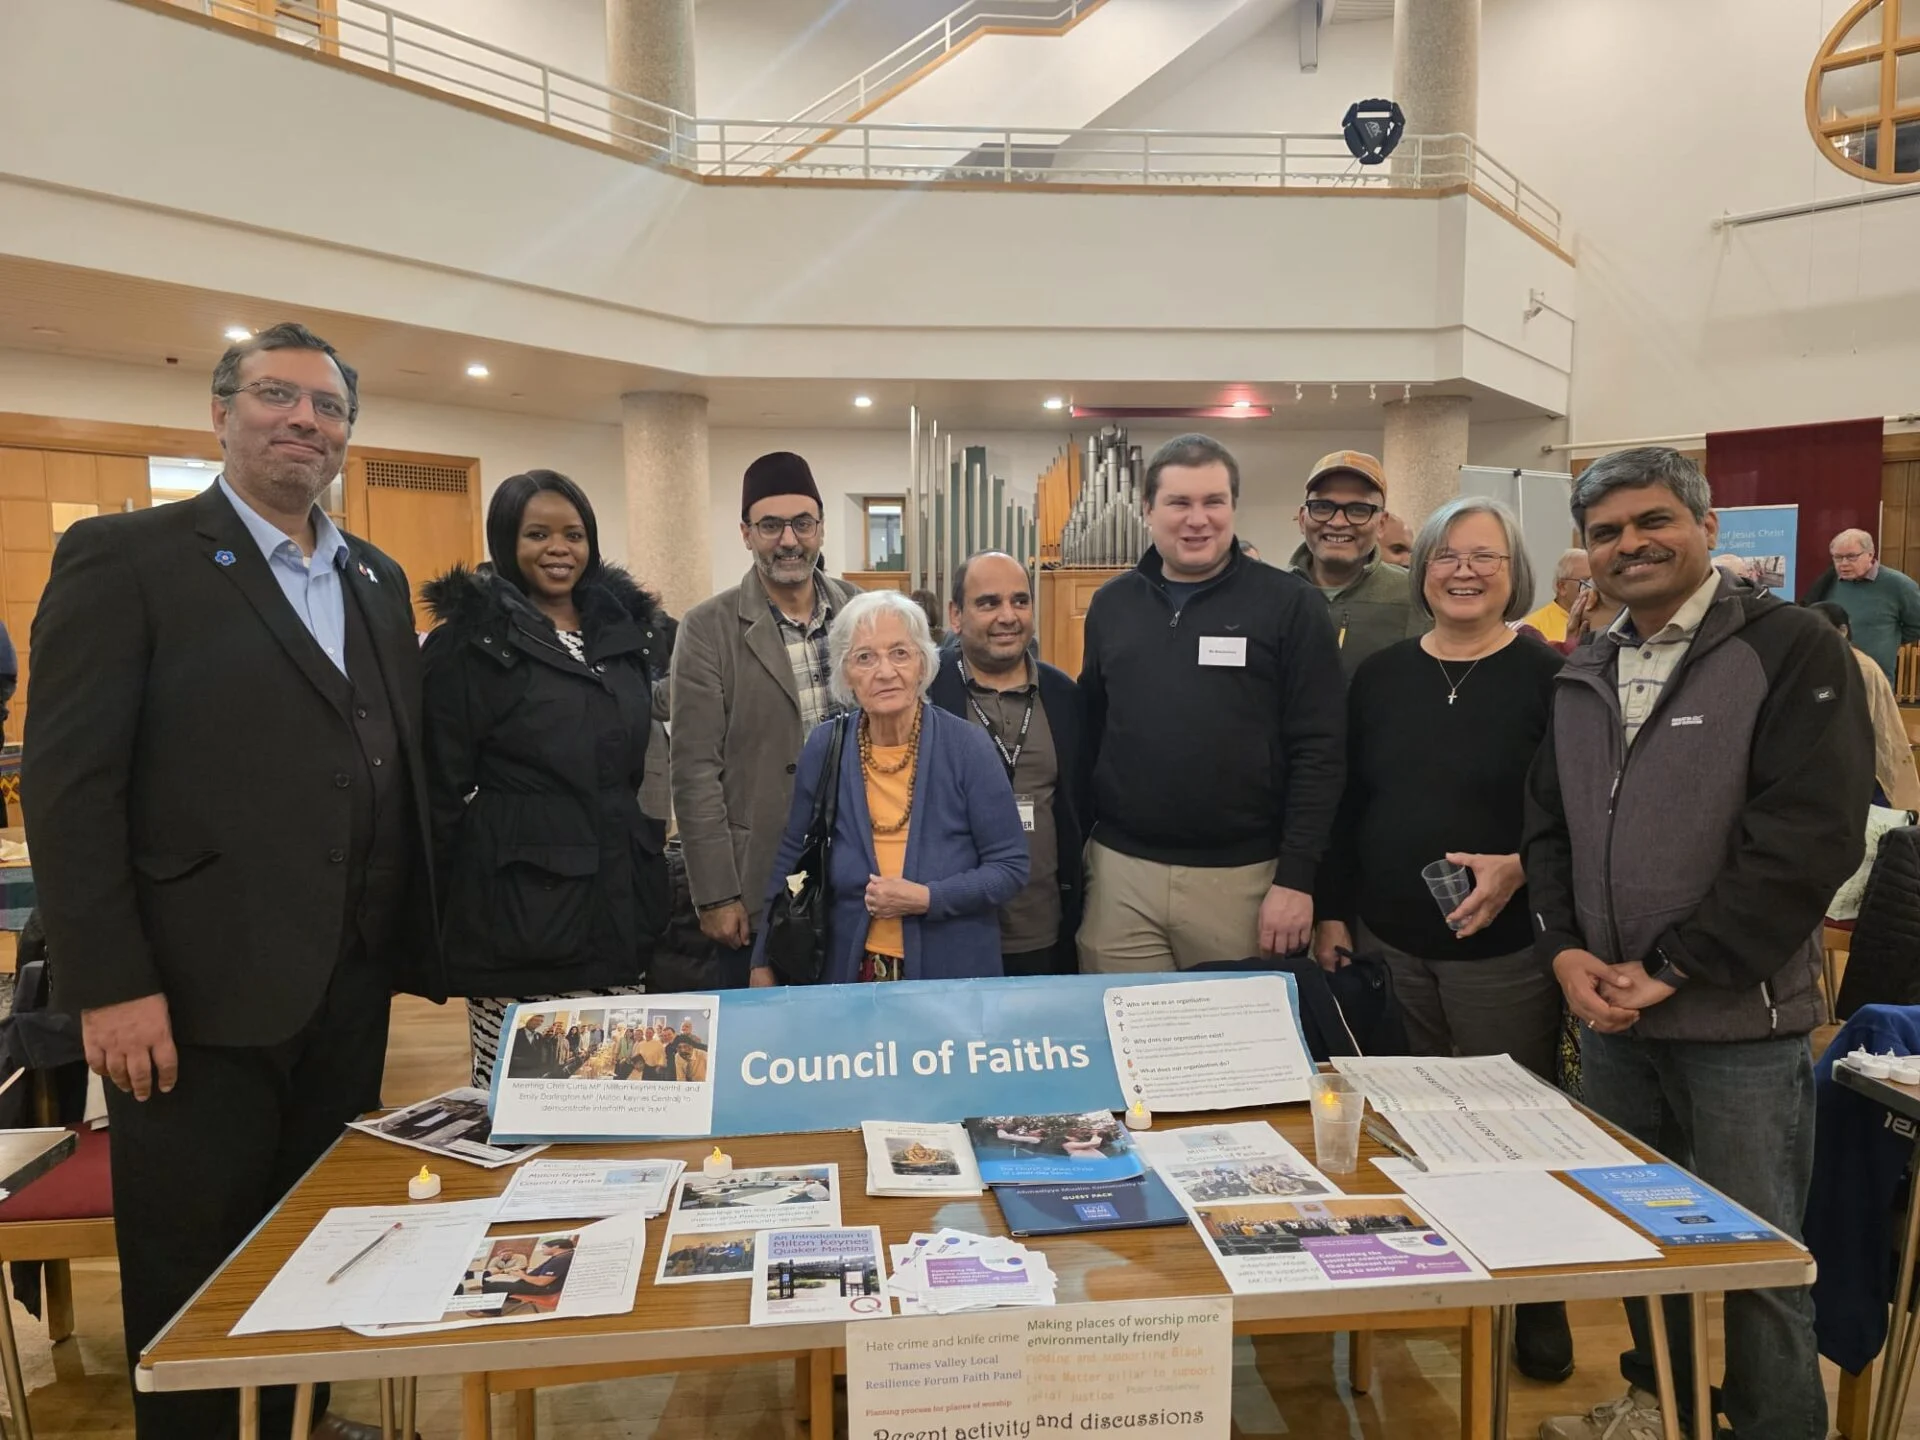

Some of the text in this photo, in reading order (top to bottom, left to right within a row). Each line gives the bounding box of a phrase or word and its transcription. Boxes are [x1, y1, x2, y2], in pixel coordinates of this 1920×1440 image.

[1732, 530, 1756, 540] Jesus
[1758, 528, 1785, 537] Christ
[741, 1037, 1090, 1085] Council of Faiths
[512, 1082, 545, 1090] Meeting
[631, 1083, 656, 1092] Keynes
[1601, 1170, 1658, 1179] JESUS
[773, 1239, 869, 1248] Milton Keynes
[773, 1246, 869, 1255] Quaker Meeting
[1319, 1251, 1368, 1259] Celebrating
[1346, 1260, 1382, 1268] different
[1366, 1266, 1396, 1274] society
[1027, 1312, 1220, 1334] Making places of worship more
[866, 1332, 1020, 1352] Hate crime and knife crime
[1027, 1330, 1180, 1348] environmentally friendly
[888, 1354, 999, 1372] Thames Valley Local
[1077, 1352, 1096, 1363] and
[1102, 1350, 1167, 1364] supporting
[1172, 1346, 1204, 1358] Black
[866, 1369, 1022, 1390] Resilience Forum Faith Panel
[1063, 1370, 1101, 1383] Matter
[1108, 1369, 1145, 1384] pillar
[1153, 1367, 1167, 1378] to
[1172, 1365, 1216, 1379] support
[1071, 1389, 1115, 1403] justice
[866, 1408, 900, 1416] Planning
[901, 1406, 931, 1416] process
[945, 1403, 971, 1413] places
[982, 1399, 1012, 1409] worship
[874, 1408, 1204, 1440] Recent activity and discussions
